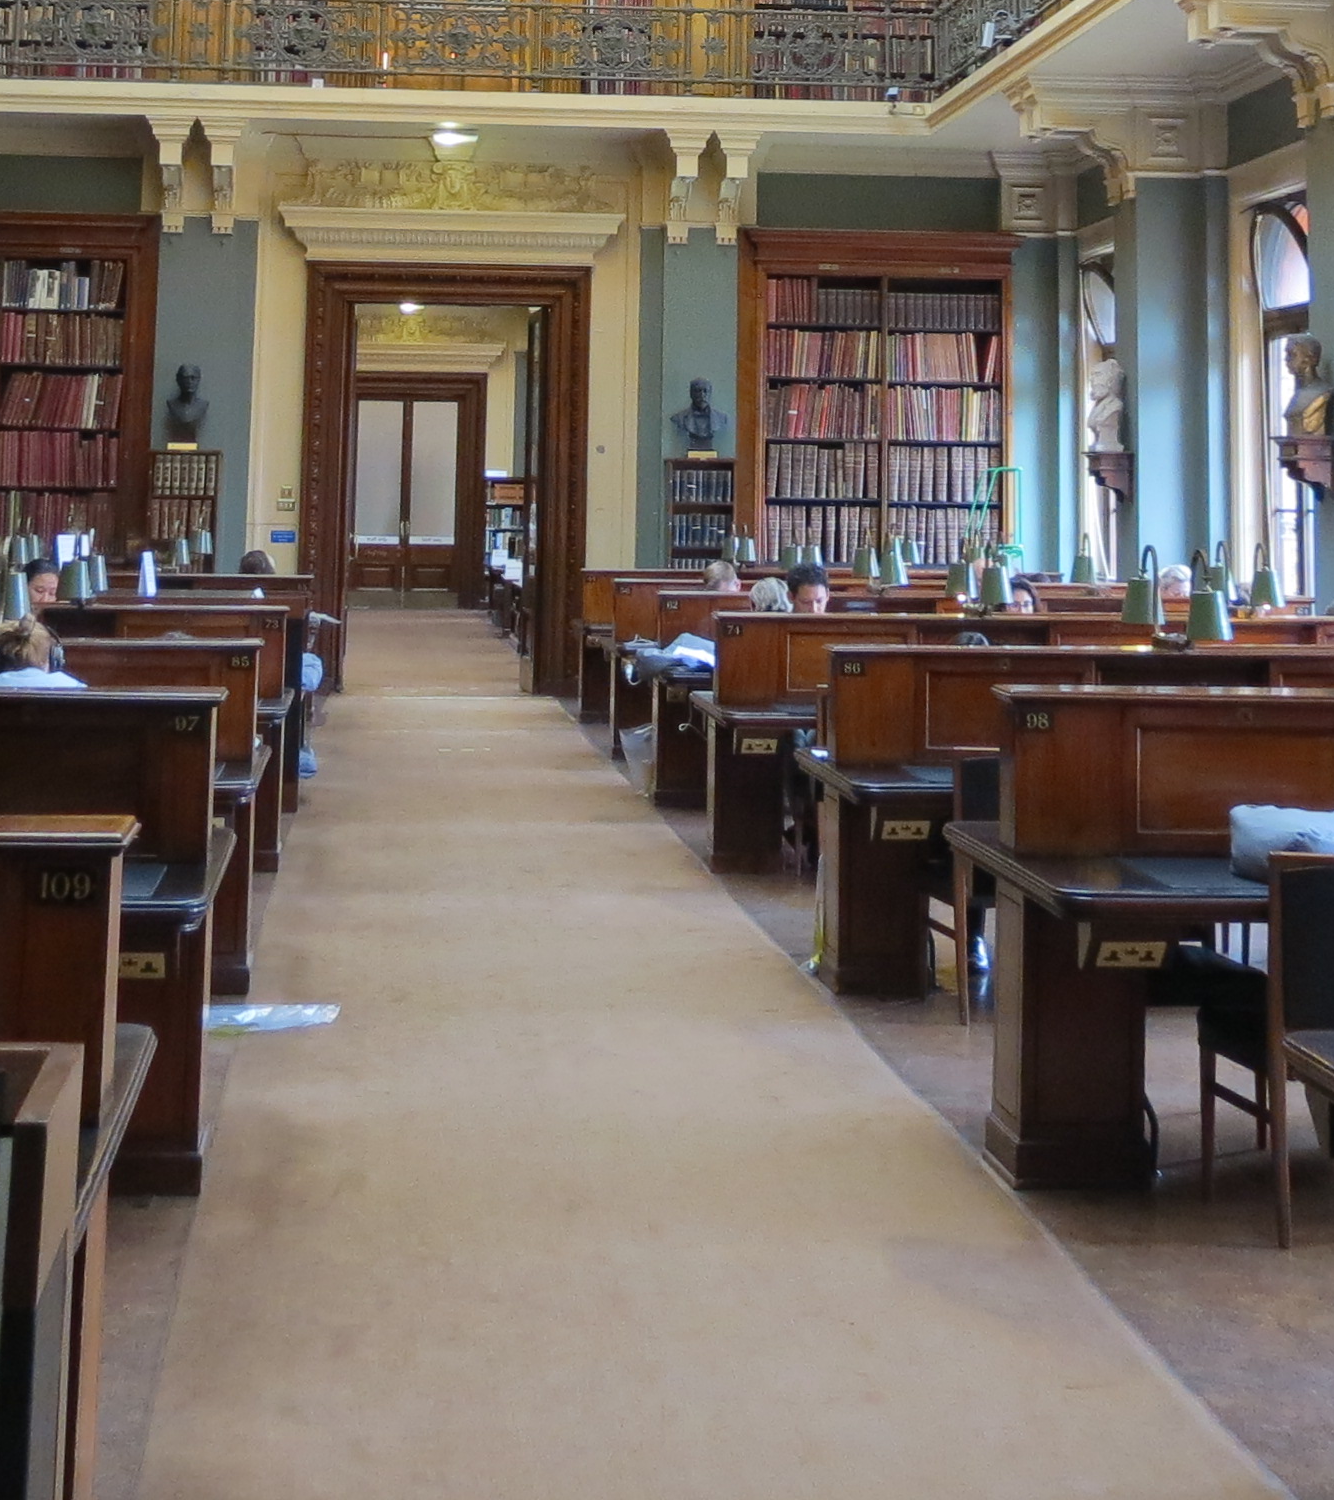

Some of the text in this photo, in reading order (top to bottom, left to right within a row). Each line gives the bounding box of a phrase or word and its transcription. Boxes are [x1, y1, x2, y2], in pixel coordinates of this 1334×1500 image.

[666, 600, 678, 610] 62
[265, 618, 279, 629] 73
[727, 624, 740, 636] 74
[230, 655, 250, 668] 85
[843, 661, 861, 674] 86
[174, 715, 200, 732] 97
[1025, 712, 1050, 730] 98
[41, 871, 92, 900] 109
